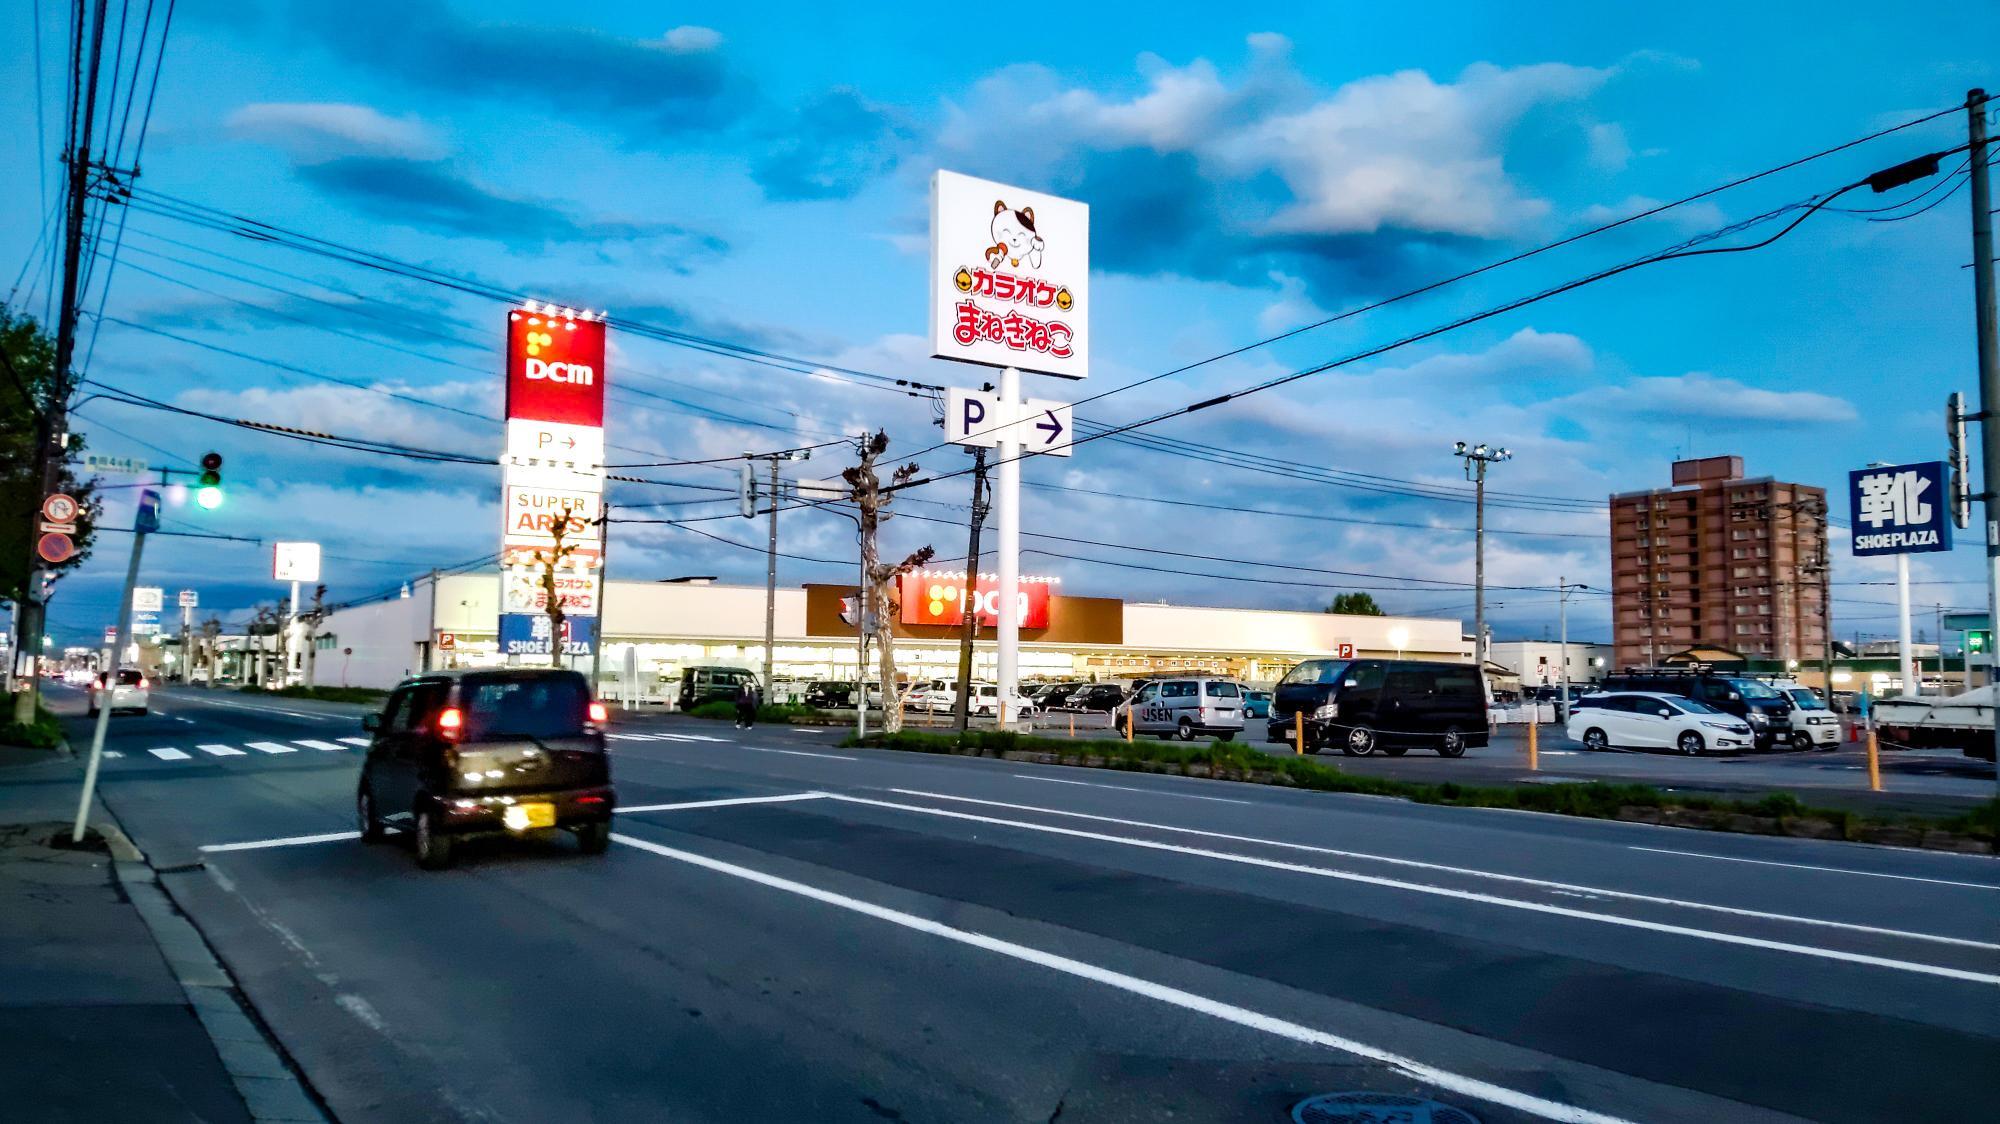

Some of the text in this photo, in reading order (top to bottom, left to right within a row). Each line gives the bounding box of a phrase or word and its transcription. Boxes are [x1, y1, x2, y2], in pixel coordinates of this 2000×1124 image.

[972, 269, 1057, 306] カラオケ
[954, 300, 1073, 357] まねきねこ
[963, 398, 985, 435] P
[539, 432, 553, 448] P
[518, 493, 585, 511] SUPER
[1858, 470, 1932, 528] 靴
[553, 578, 585, 590] ラオケ
[535, 592, 592, 609] まきねこ
[1341, 645, 1351, 657] P
[1142, 708, 1173, 722] USEN
